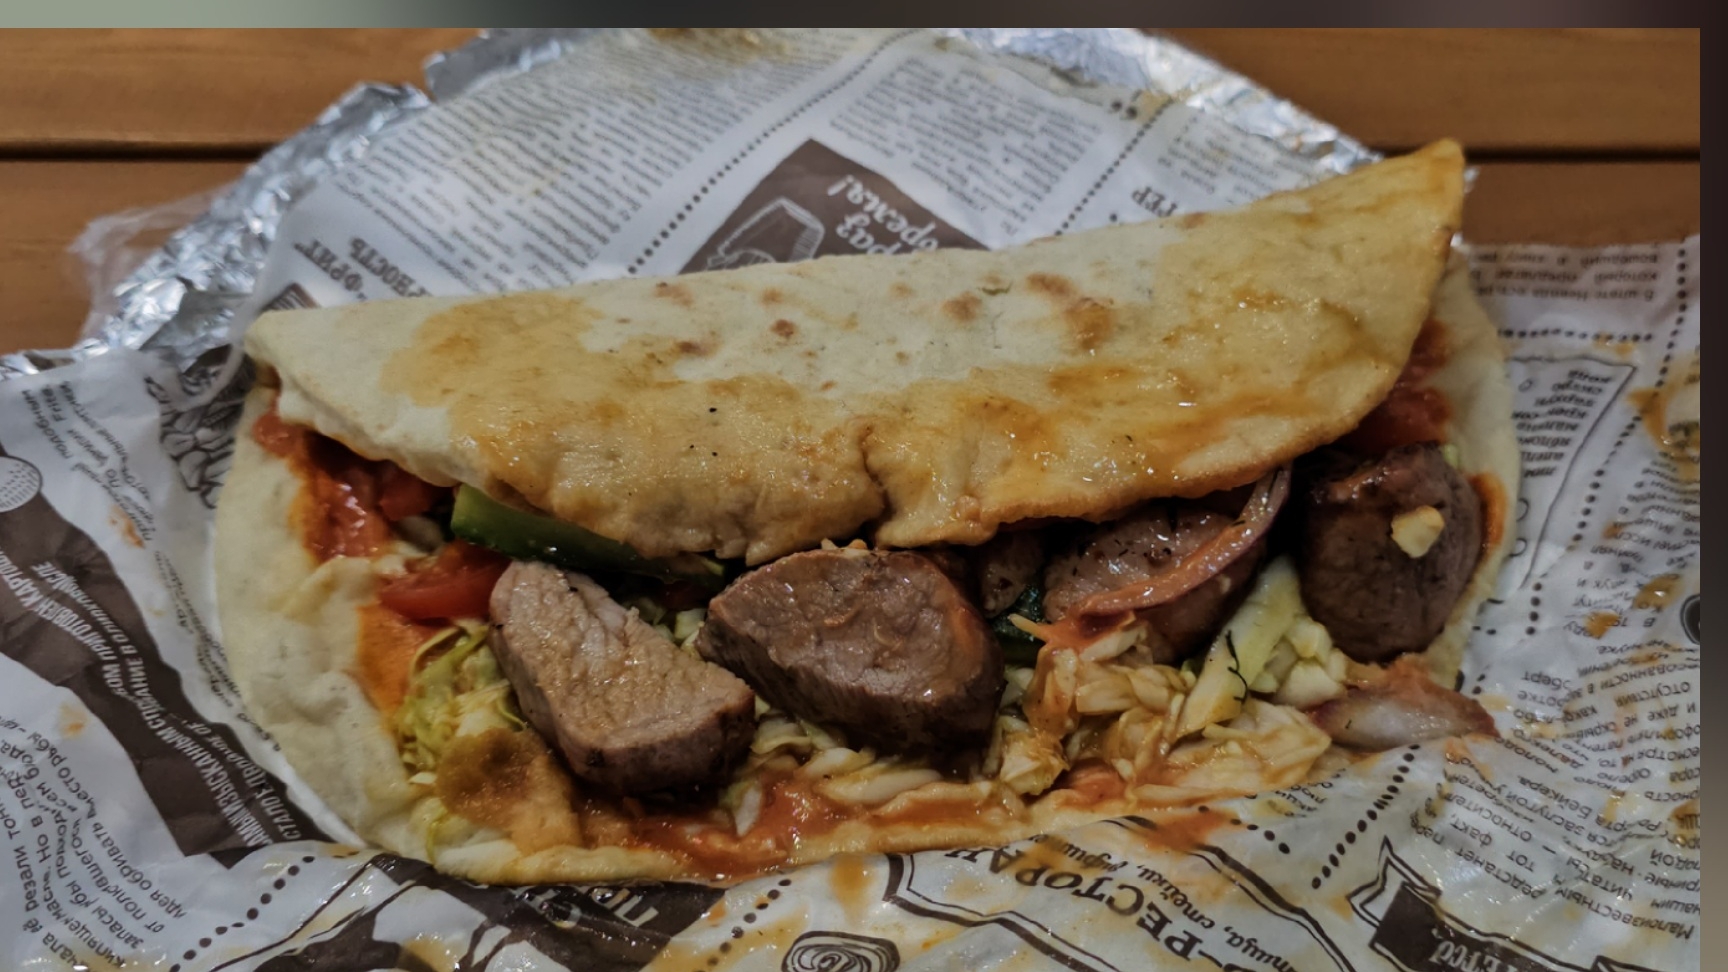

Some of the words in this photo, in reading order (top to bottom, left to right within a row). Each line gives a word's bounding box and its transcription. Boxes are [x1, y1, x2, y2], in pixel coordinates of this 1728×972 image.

[20, 387, 73, 460] подобным
[154, 724, 246, 816] ИЗЫСКАННЫМ
[1445, 811, 1494, 849] факт,
[1504, 788, 1585, 838] заслугой
[35, 831, 53, 863] Но
[1454, 843, 1543, 901] редстанет
[12, 843, 40, 912] резали
[150, 887, 188, 919] идея
[1132, 860, 1215, 932] стейки,
[90, 903, 144, 949] запасы
[1554, 883, 1695, 940] Малоизвестным
